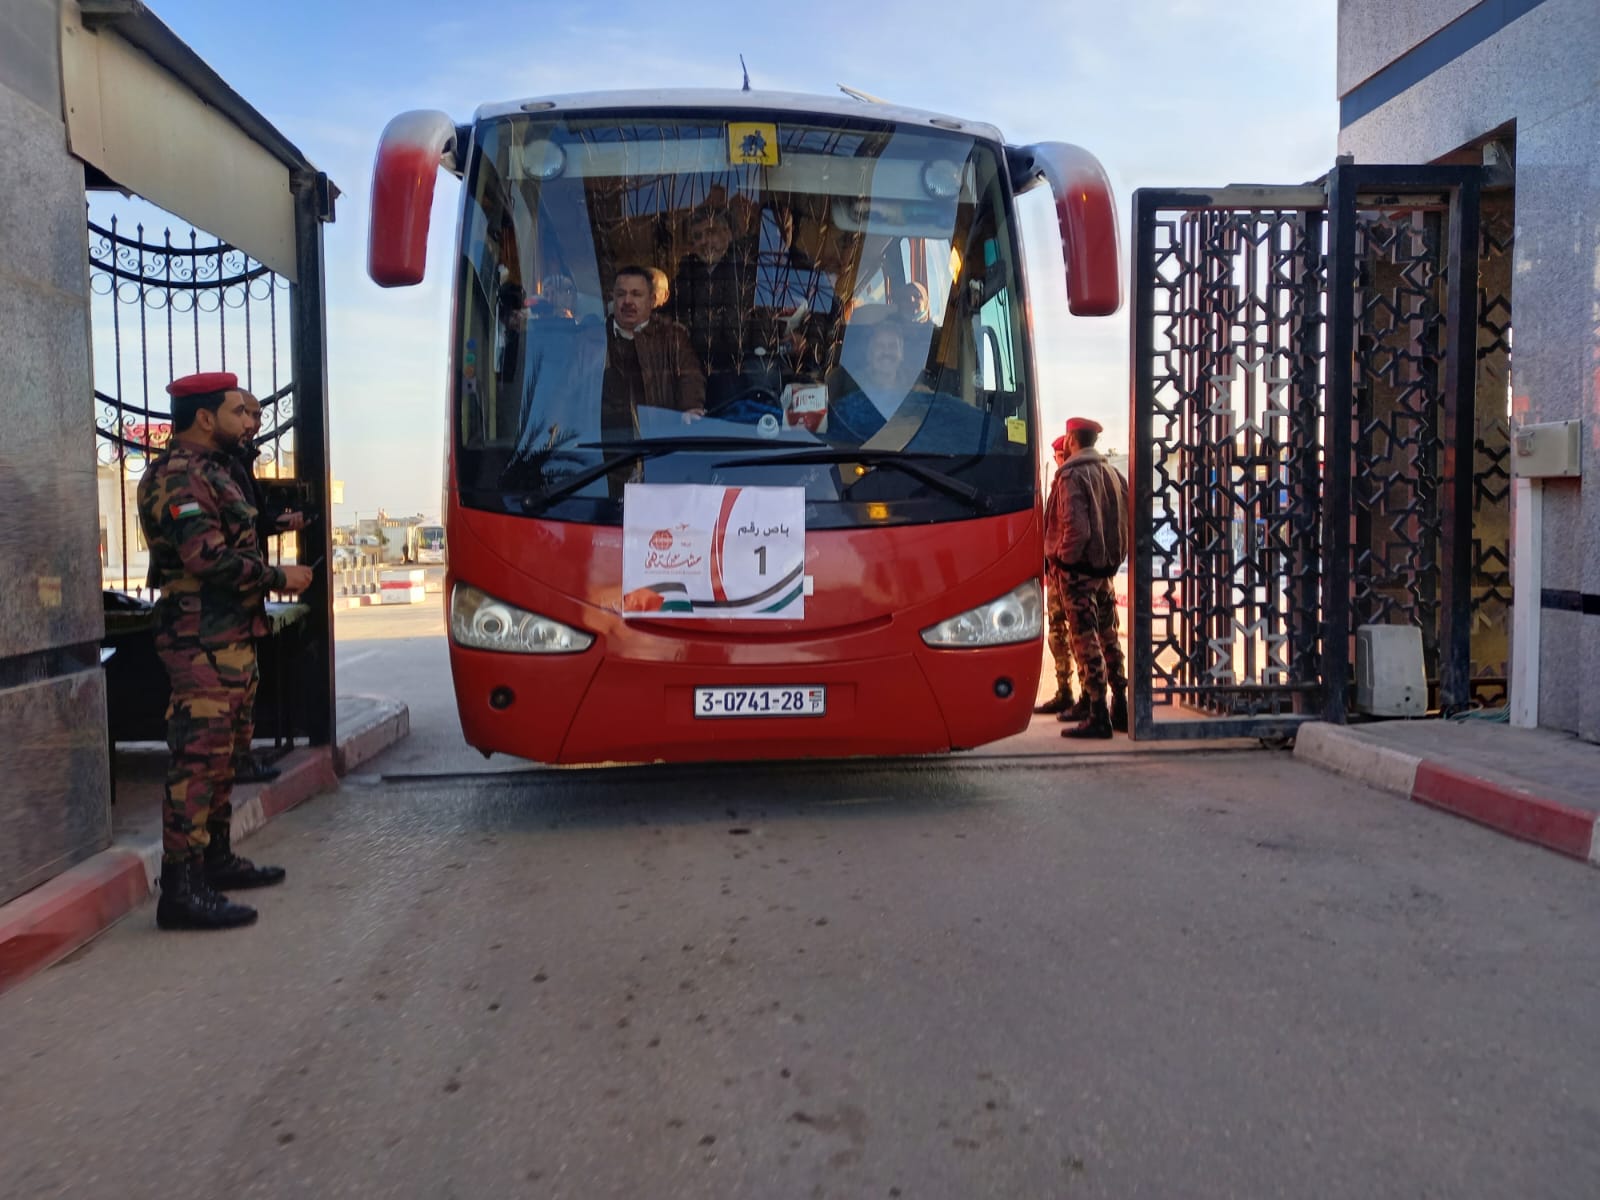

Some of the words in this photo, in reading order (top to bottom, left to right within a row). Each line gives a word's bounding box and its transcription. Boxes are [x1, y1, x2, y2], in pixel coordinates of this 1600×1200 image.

[738, 521, 760, 536] رقم
[763, 523, 789, 538] باص
[754, 545, 766, 576] 1
[702, 691, 804, 712] 3-0741-28
